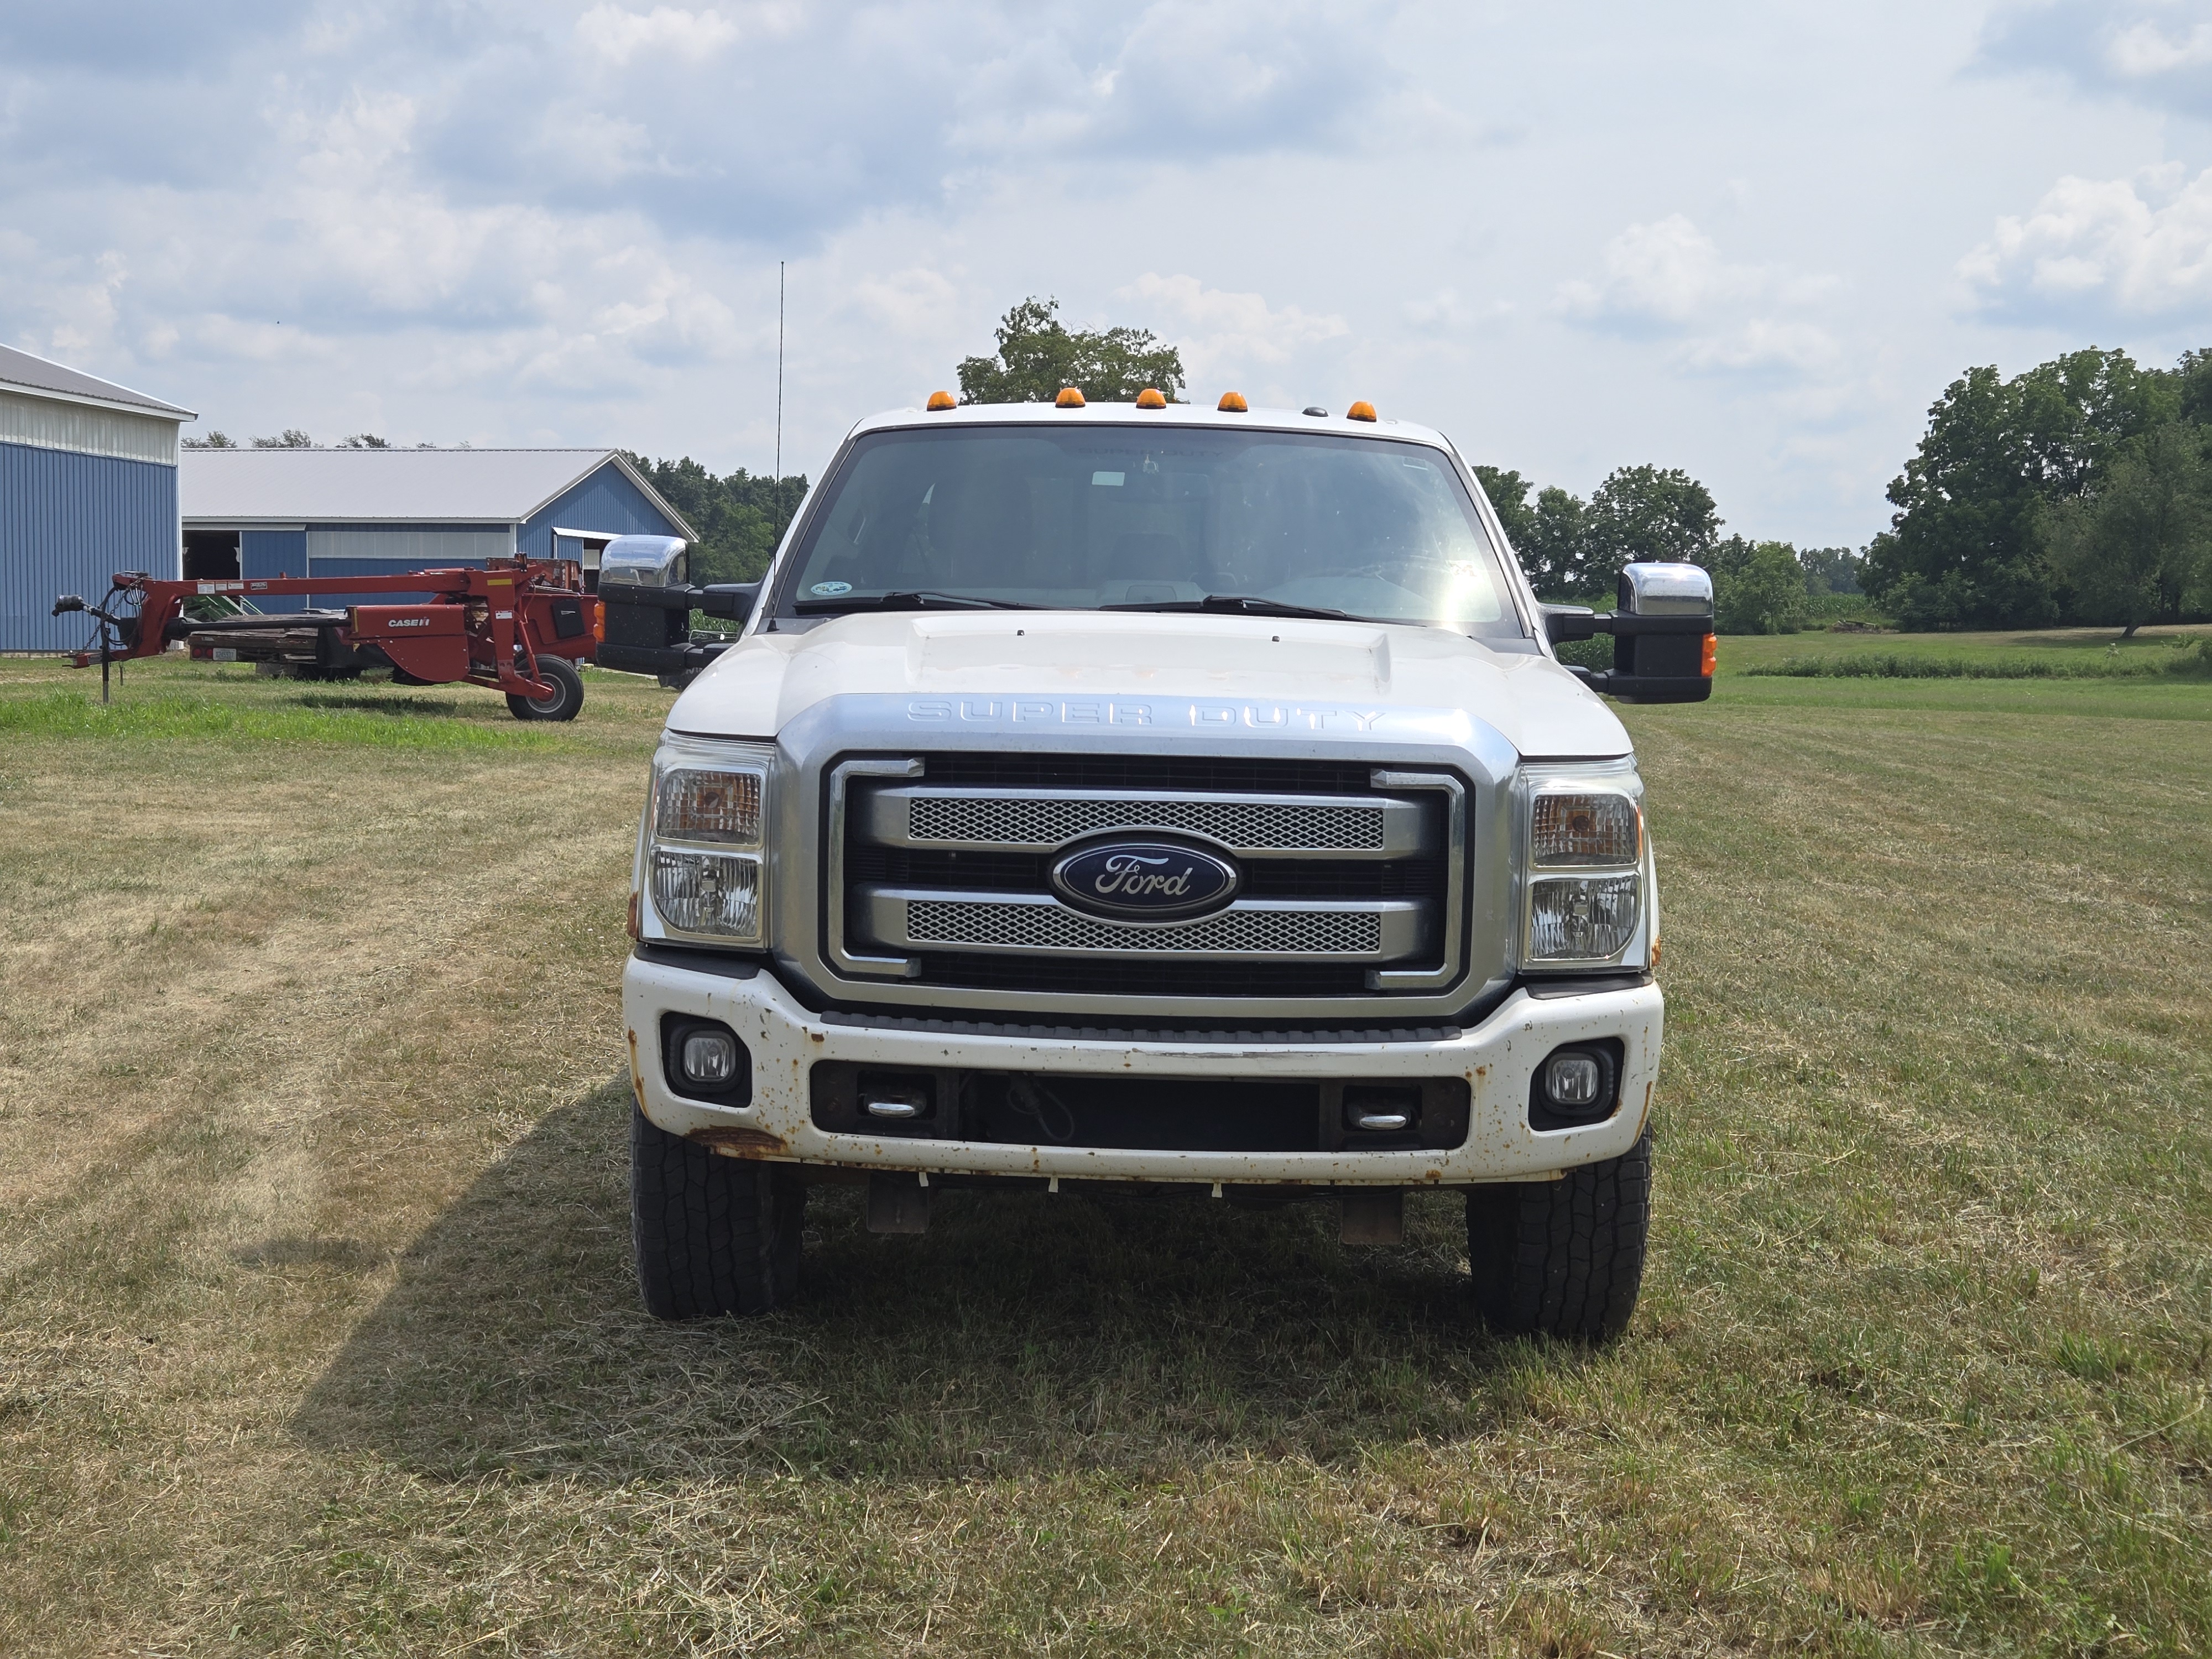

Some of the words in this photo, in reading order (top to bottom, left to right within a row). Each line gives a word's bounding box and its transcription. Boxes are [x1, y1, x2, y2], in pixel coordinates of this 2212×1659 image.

[907, 700, 1152, 725] SUPER
[1189, 704, 1386, 732] DUTY
[1095, 854, 1193, 895] Ford
